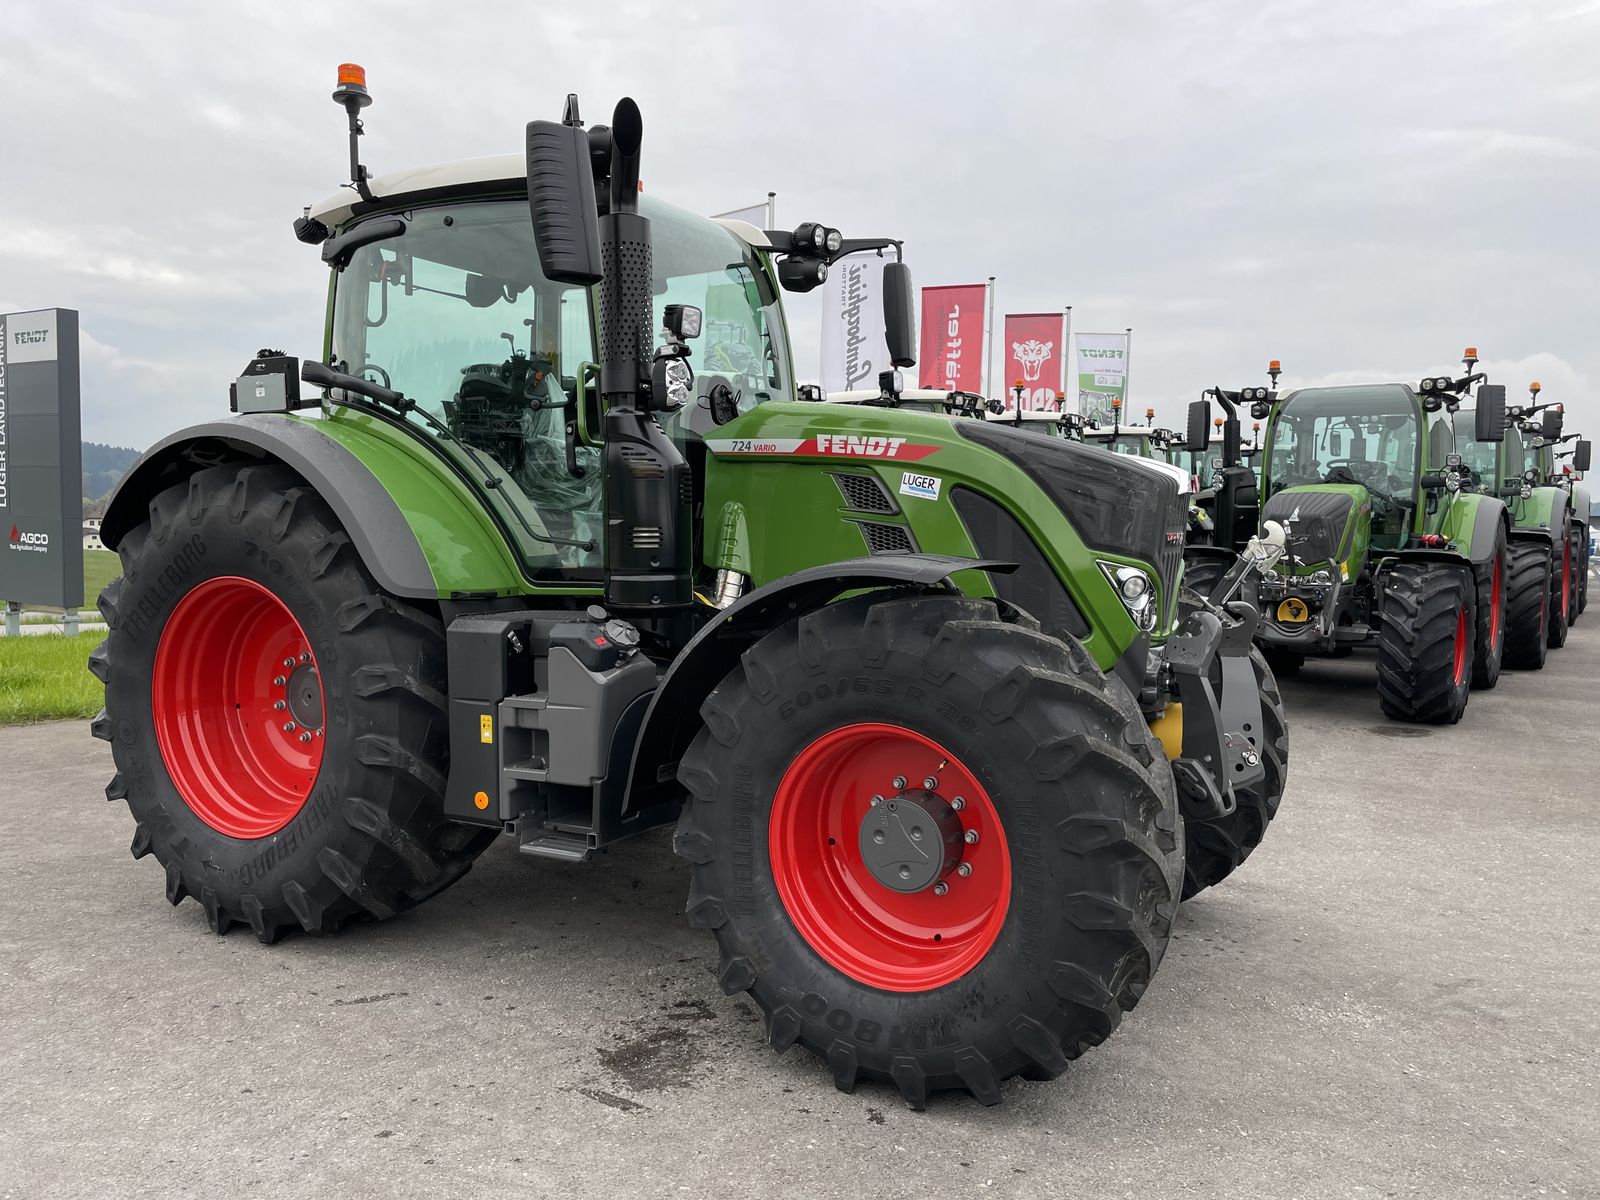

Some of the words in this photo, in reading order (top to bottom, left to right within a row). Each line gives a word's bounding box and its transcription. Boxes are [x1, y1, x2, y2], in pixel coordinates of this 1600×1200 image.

[14, 329, 49, 345] FENDT
[731, 440, 752, 452] 724
[753, 444, 777, 452] VARIO
[816, 433, 907, 457] FENDT
[902, 474, 935, 490] LUGER
[20, 532, 49, 545] AGCO
[121, 532, 208, 643] TRELLEBORG
[778, 675, 895, 722] 600/65
[732, 763, 754, 918] TRELLEBORG
[799, 991, 961, 1052] TM800
